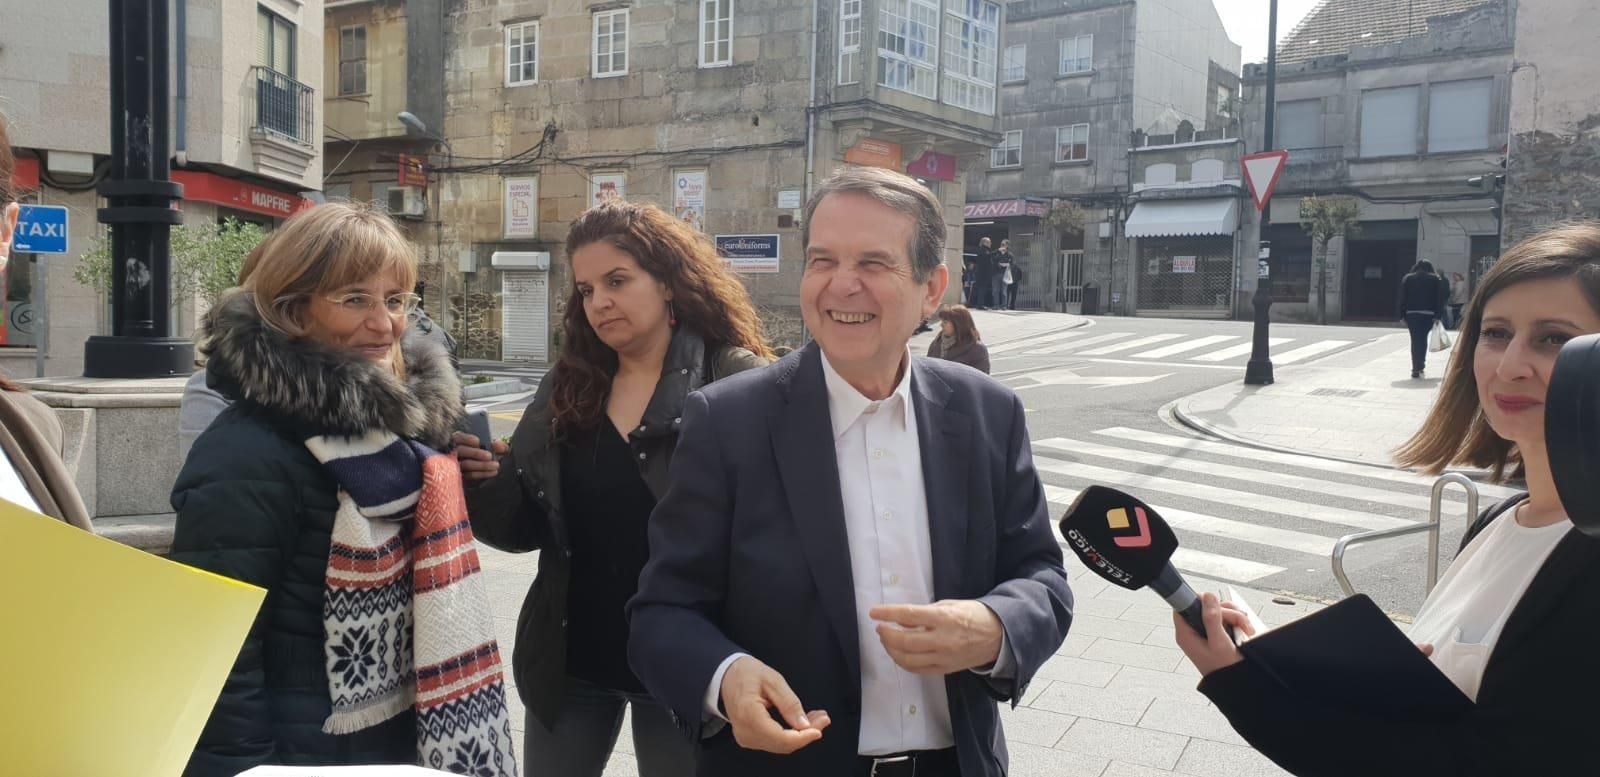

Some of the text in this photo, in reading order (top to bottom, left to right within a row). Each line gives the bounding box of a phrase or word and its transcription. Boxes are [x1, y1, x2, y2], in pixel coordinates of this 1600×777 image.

[252, 192, 290, 213] MAPFRE
[18, 221, 64, 238] TAXI
[1068, 530, 1130, 584] TELEVIGO
